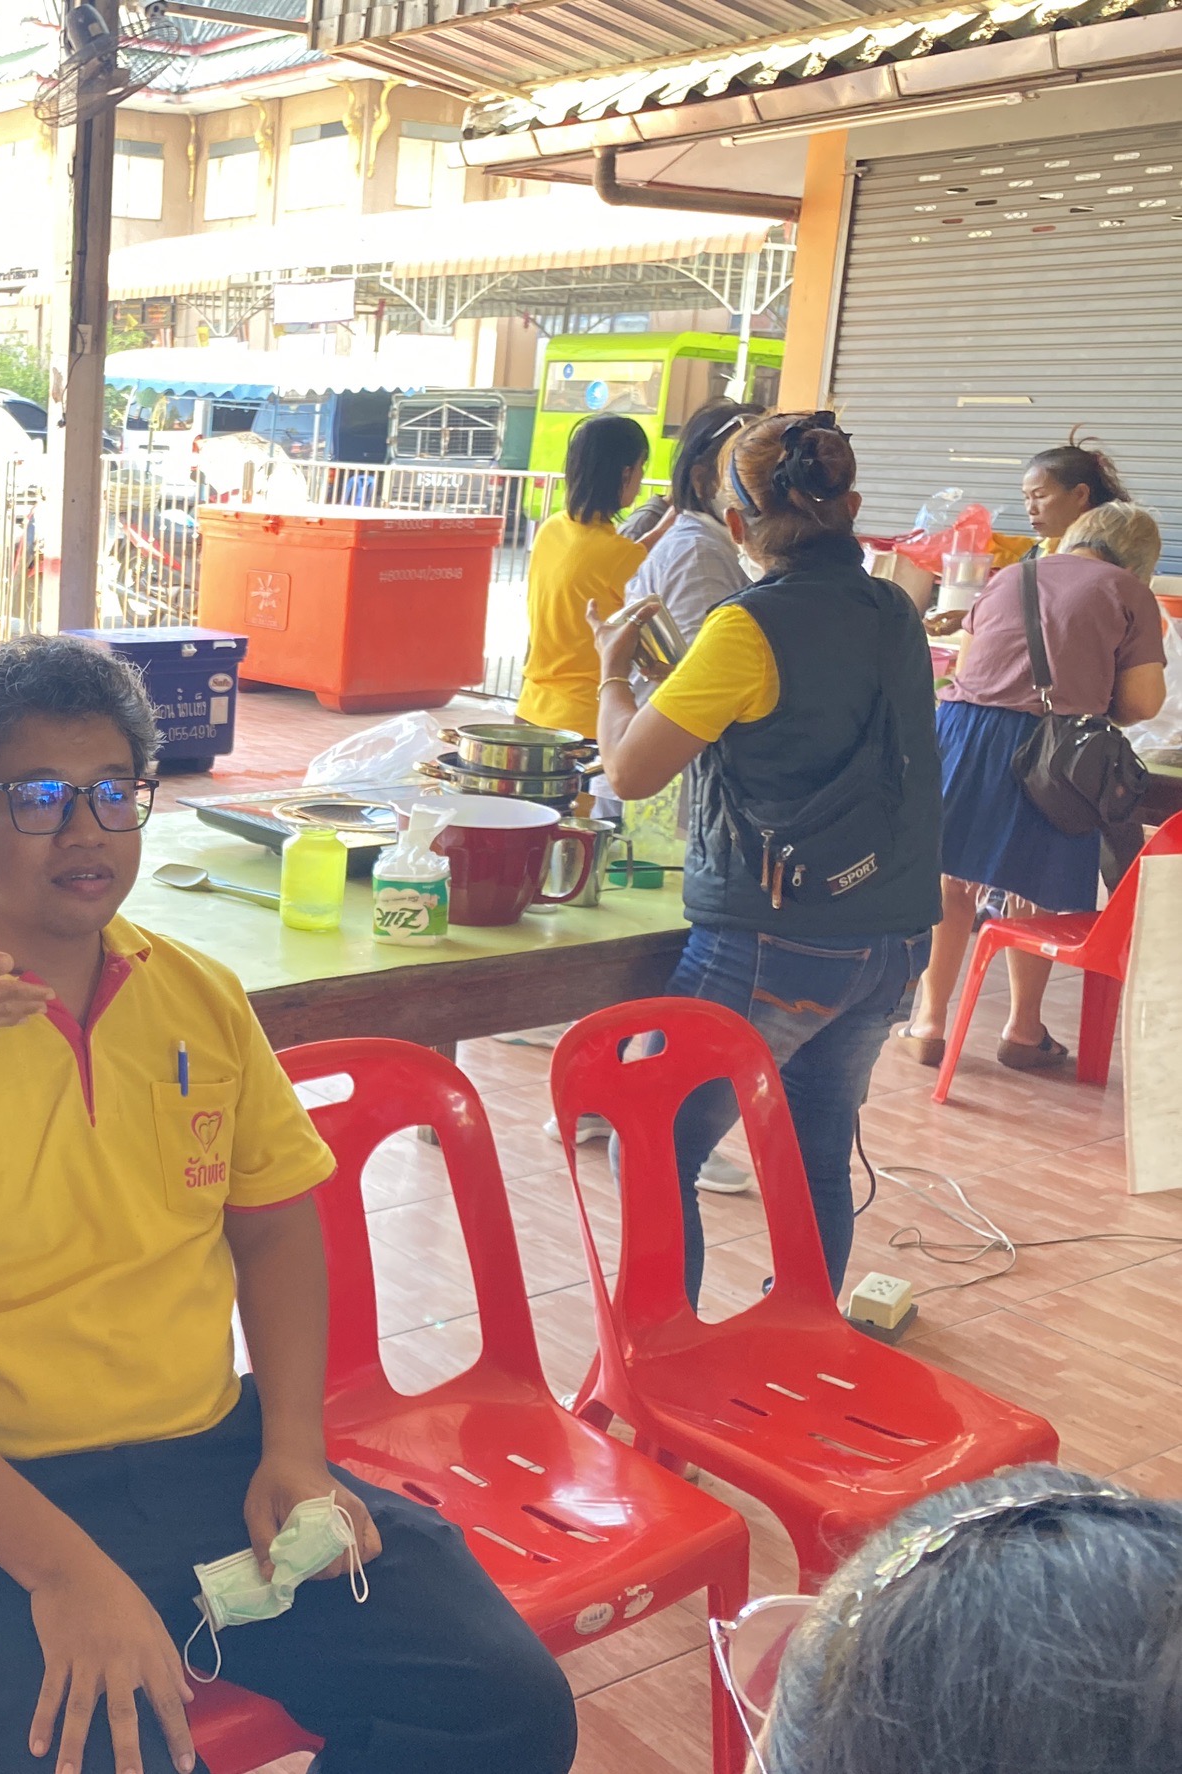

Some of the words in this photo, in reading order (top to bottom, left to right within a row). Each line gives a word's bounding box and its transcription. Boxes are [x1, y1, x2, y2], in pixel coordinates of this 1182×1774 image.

[416, 472, 465, 488] ISUZU
[838, 857, 876, 888] SPORT
[375, 907, 424, 929] Zilk
[183, 1152, 227, 1188] รักพ่อ
